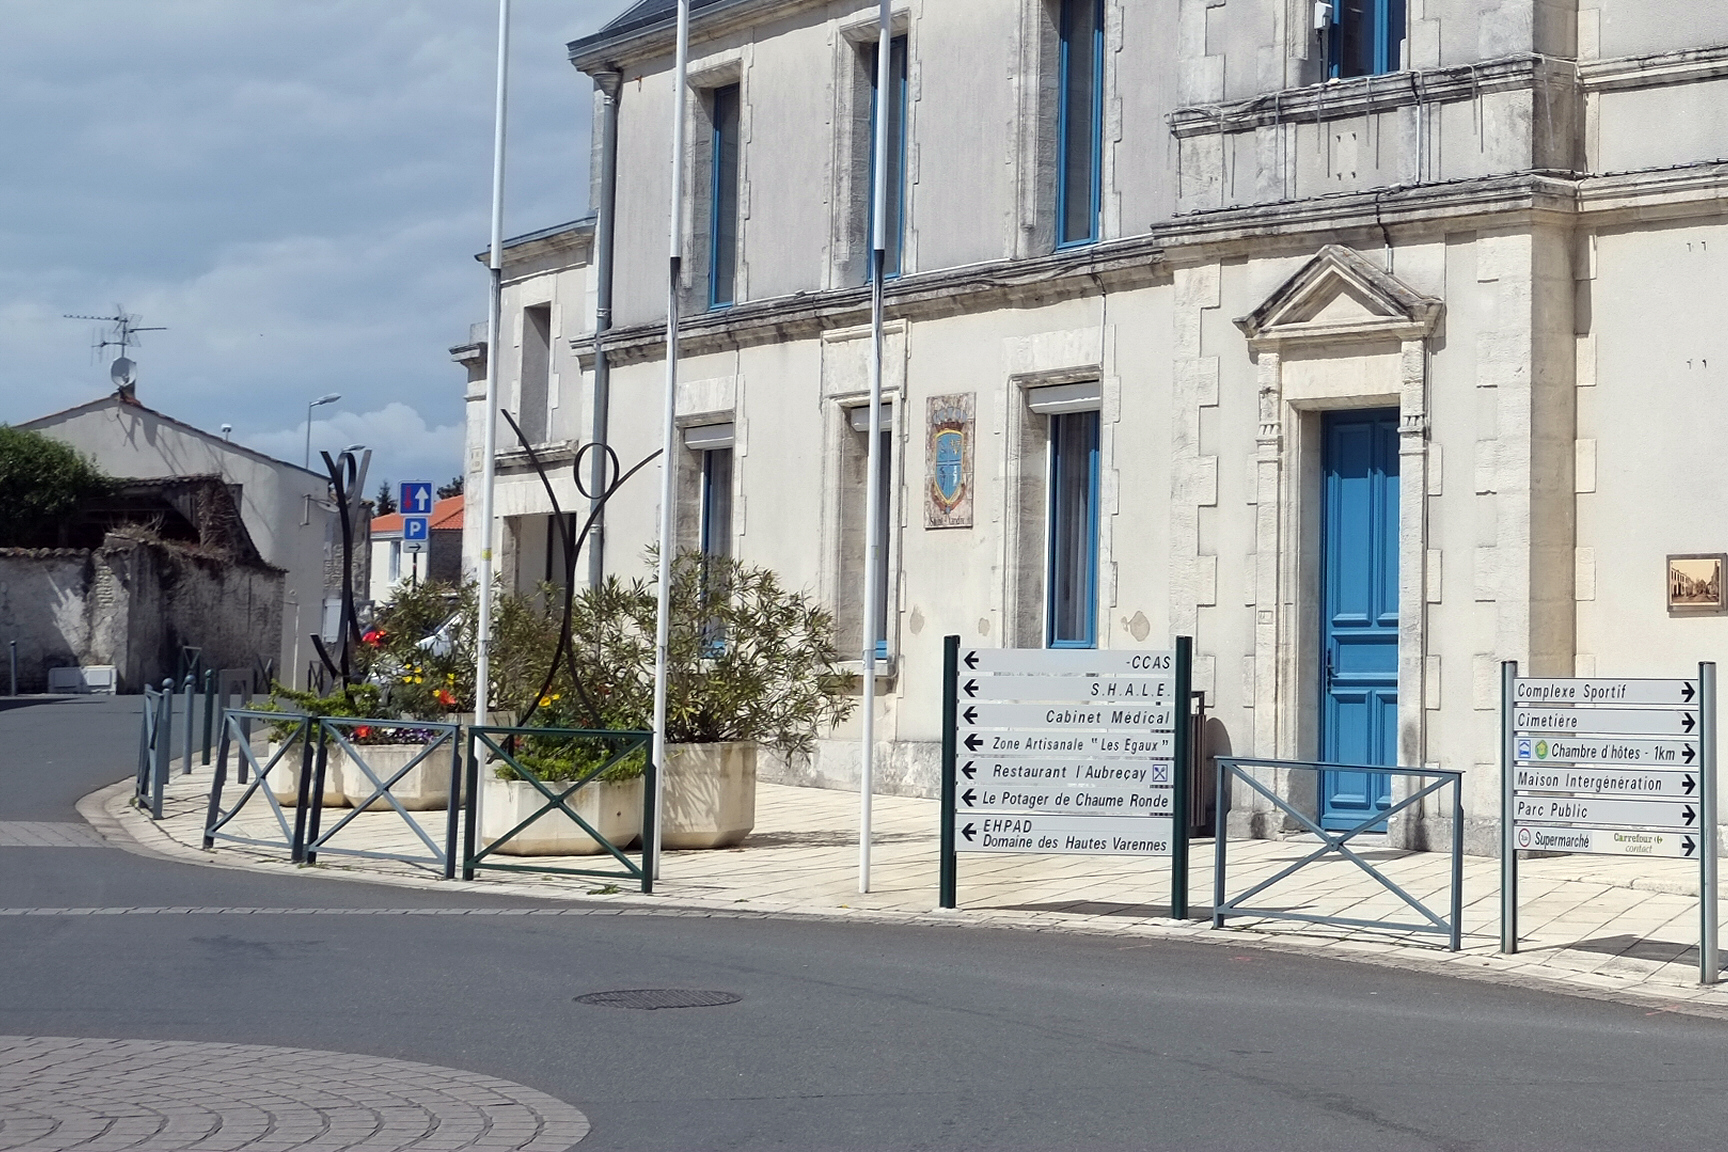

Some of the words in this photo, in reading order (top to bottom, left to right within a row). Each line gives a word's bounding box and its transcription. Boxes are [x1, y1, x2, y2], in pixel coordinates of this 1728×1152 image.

[409, 521, 421, 537] P
[1517, 682, 1576, 701] Complexe
[1583, 683, 1627, 702] Sportif
[1046, 709, 1101, 724] Cabinet
[1111, 710, 1170, 725] Médical
[1517, 712, 1578, 728] Cimetière
[993, 736, 1020, 750] Zone
[1025, 737, 1084, 751] Artisanale
[1551, 742, 1597, 759] Chambre
[1601, 744, 1640, 760] d'hôtes
[1654, 745, 1675, 761] 1km
[993, 764, 1067, 779] Restaurant
[1517, 771, 1559, 787] Maison
[1565, 773, 1662, 793] Intergénération
[982, 791, 996, 805] Le
[1001, 791, 1049, 809] Potager
[1055, 792, 1070, 806] de
[1075, 792, 1123, 807] Chaume
[1129, 793, 1169, 808] Ronde
[1517, 801, 1544, 816] Parc
[1550, 802, 1588, 819] Public
[983, 819, 1033, 833] EHPAD
[982, 834, 1032, 849] Domaine
[1038, 835, 1058, 849] des
[1065, 836, 1107, 850] Hautes
[1112, 837, 1167, 851] Varennes
[1535, 831, 1590, 849] Supermarché
[1613, 832, 1653, 843] Carrefour
